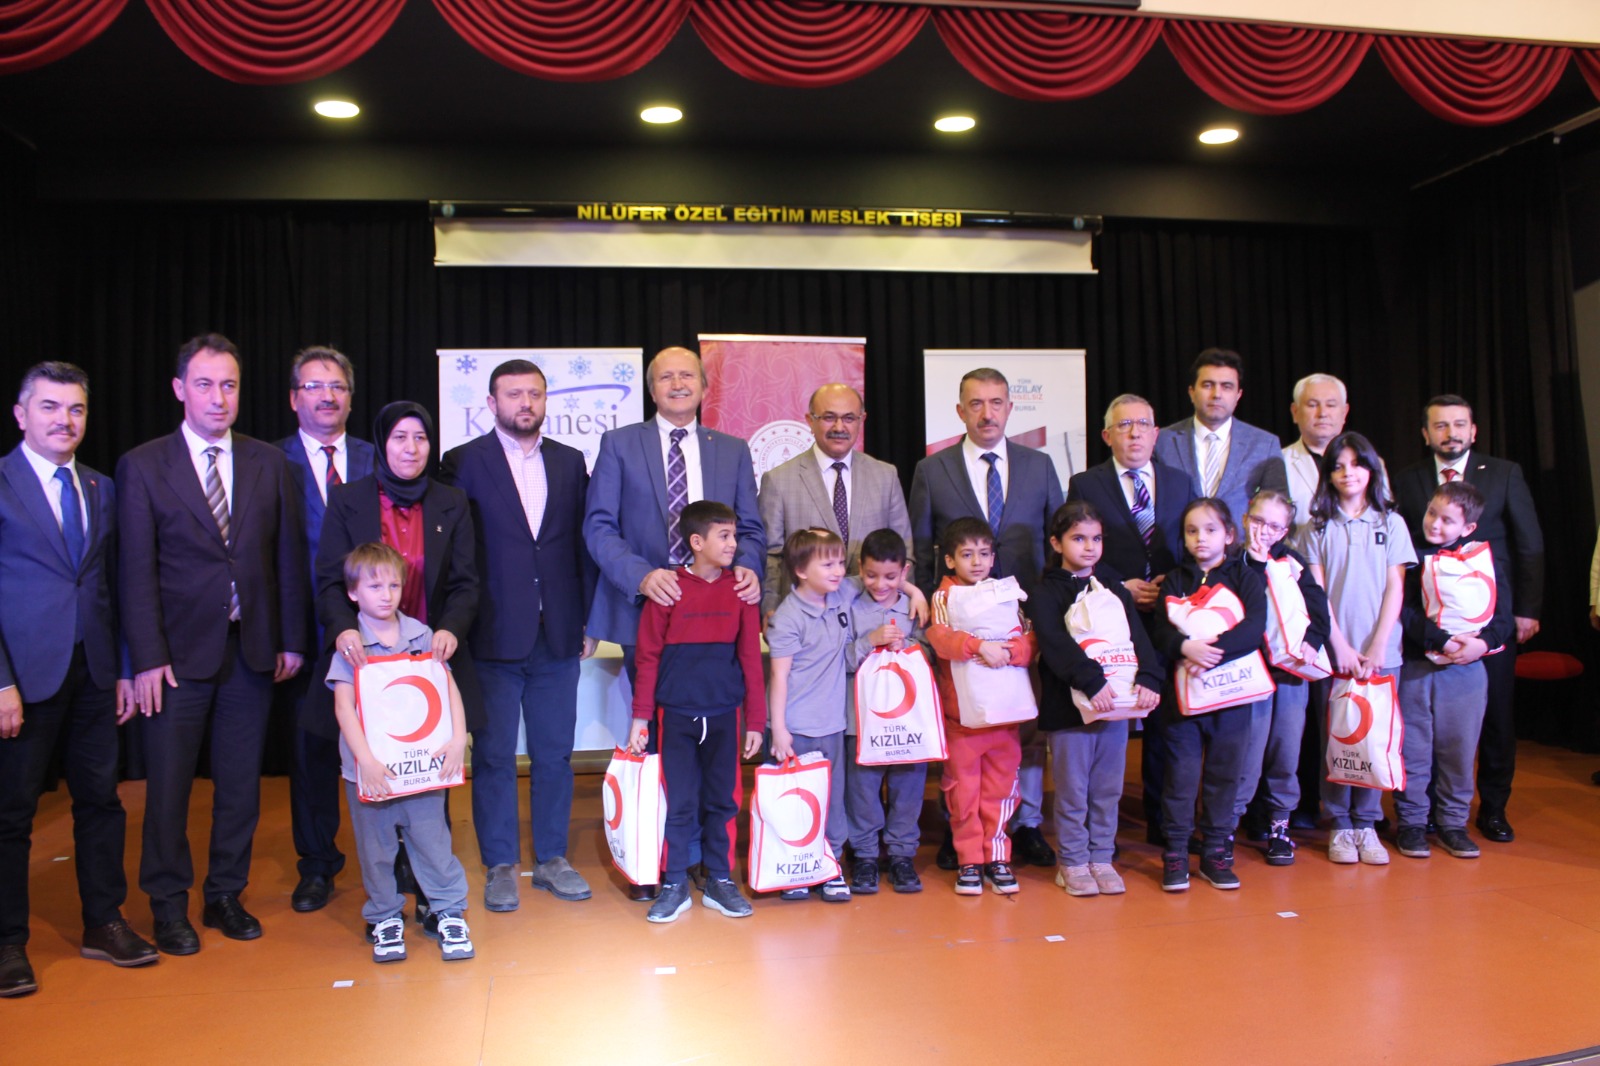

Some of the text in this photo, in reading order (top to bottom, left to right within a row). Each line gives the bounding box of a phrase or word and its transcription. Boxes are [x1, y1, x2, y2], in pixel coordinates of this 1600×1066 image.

[577, 203, 962, 227] NİLÜFER ÖZEL EĞİTİM MESLEK LİSESİ
[462, 404, 618, 437] Kanesi
[1201, 666, 1252, 690] KIZILAY
[883, 724, 907, 732] TÜRK
[870, 732, 923, 747] KIZILAY
[403, 748, 430, 759] TÜRK
[885, 749, 911, 757] BURSA
[1342, 750, 1360, 758] TÜRK
[1332, 757, 1373, 773] KIZILAY
[403, 776, 432, 786] BURSA
[1344, 772, 1364, 780] BURSA
[793, 852, 814, 861] TÜRK
